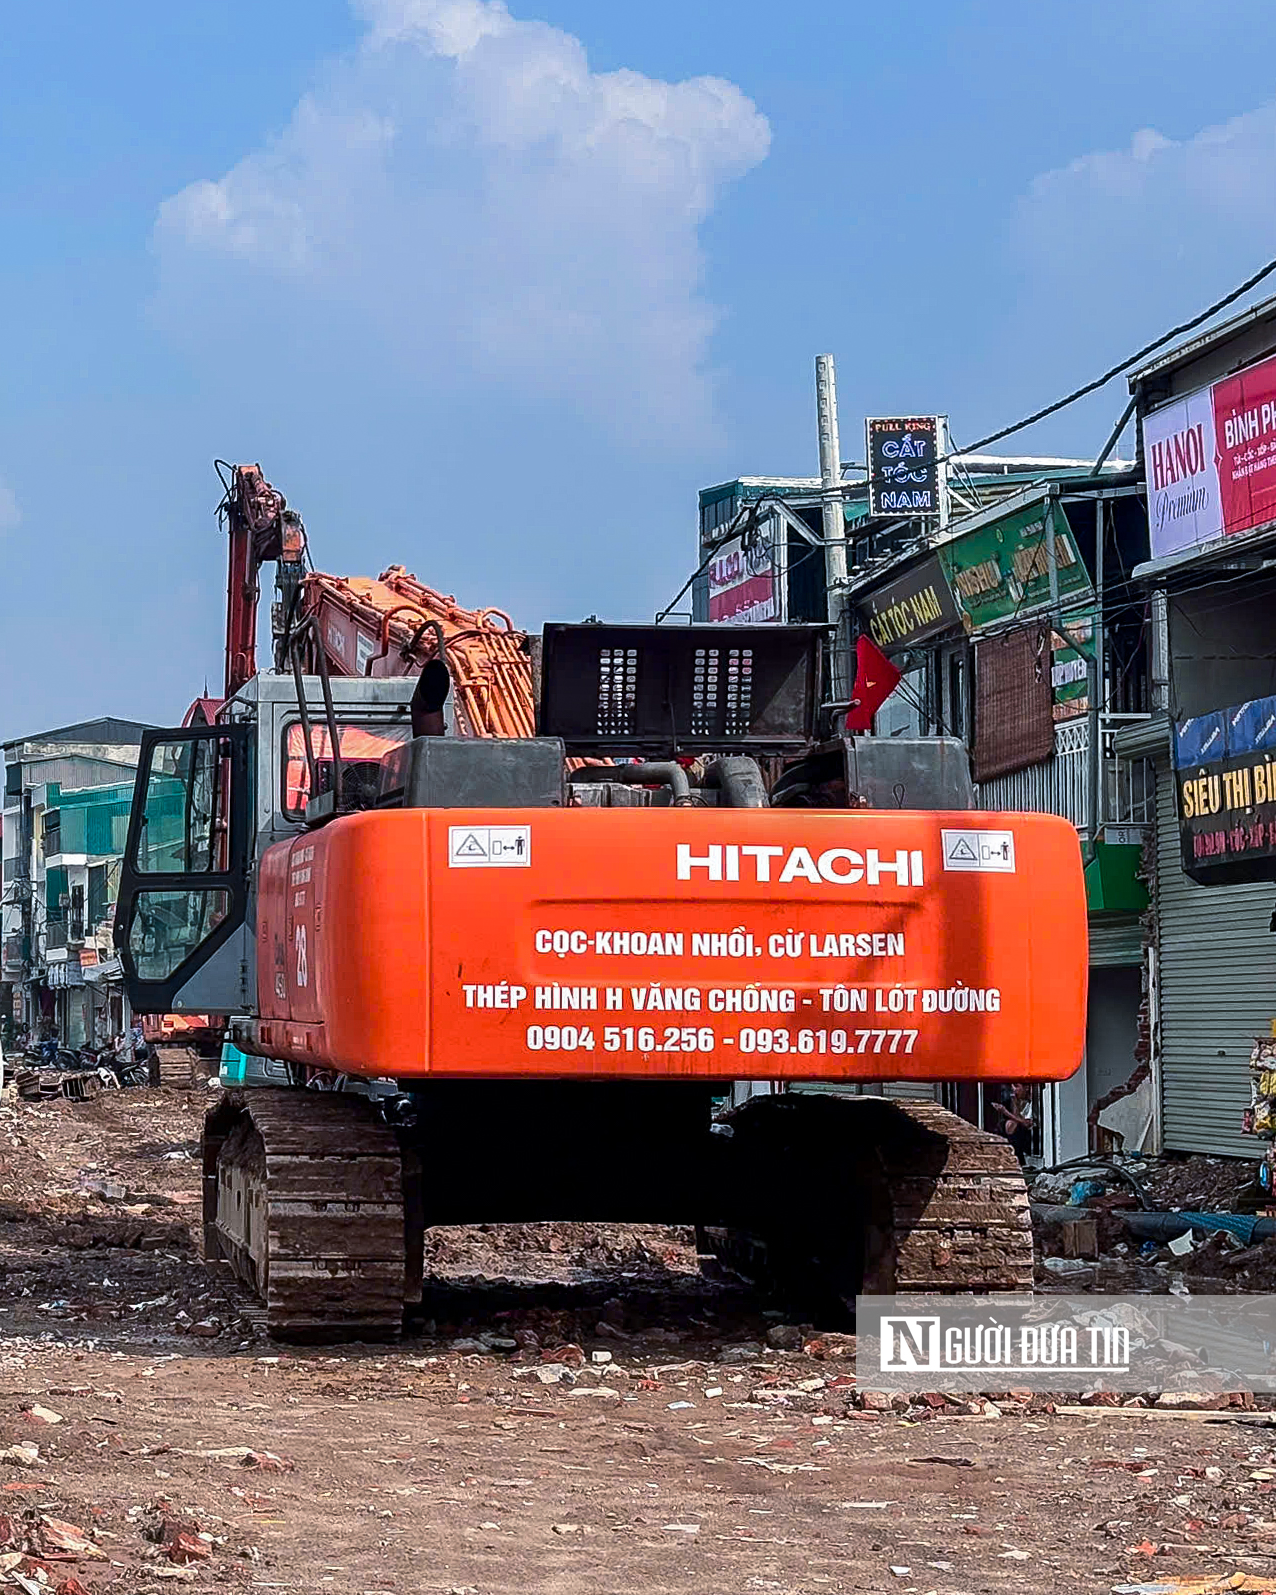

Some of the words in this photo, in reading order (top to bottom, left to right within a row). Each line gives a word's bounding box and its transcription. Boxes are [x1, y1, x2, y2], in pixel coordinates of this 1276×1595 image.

[1225, 408, 1260, 450] BÌNH
[1151, 423, 1207, 491] HANOI
[880, 490, 932, 508] NAM
[1156, 486, 1209, 532] Premium
[909, 585, 943, 627] NAM
[1183, 768, 1222, 819] SIÊU
[1223, 766, 1253, 815] THỊ
[676, 844, 924, 887] HITACHI
[535, 929, 684, 958] CỌC-KHOAN
[691, 926, 762, 957] NHỒI,
[768, 928, 805, 957] CỪ
[810, 932, 905, 957] LARSEN
[462, 981, 527, 1009] THÉP
[535, 981, 598, 1010] HÌNH
[605, 987, 623, 1010] H
[630, 982, 701, 1011] VĂNG
[708, 982, 795, 1013] CHỐNG
[819, 984, 868, 1012] TÔN
[875, 983, 918, 1012] LÓT
[921, 980, 1001, 1013] ĐƯỜNG
[527, 1025, 595, 1051] 0904
[603, 1027, 715, 1051] 516.256
[739, 1028, 919, 1054] 093.619.7777
